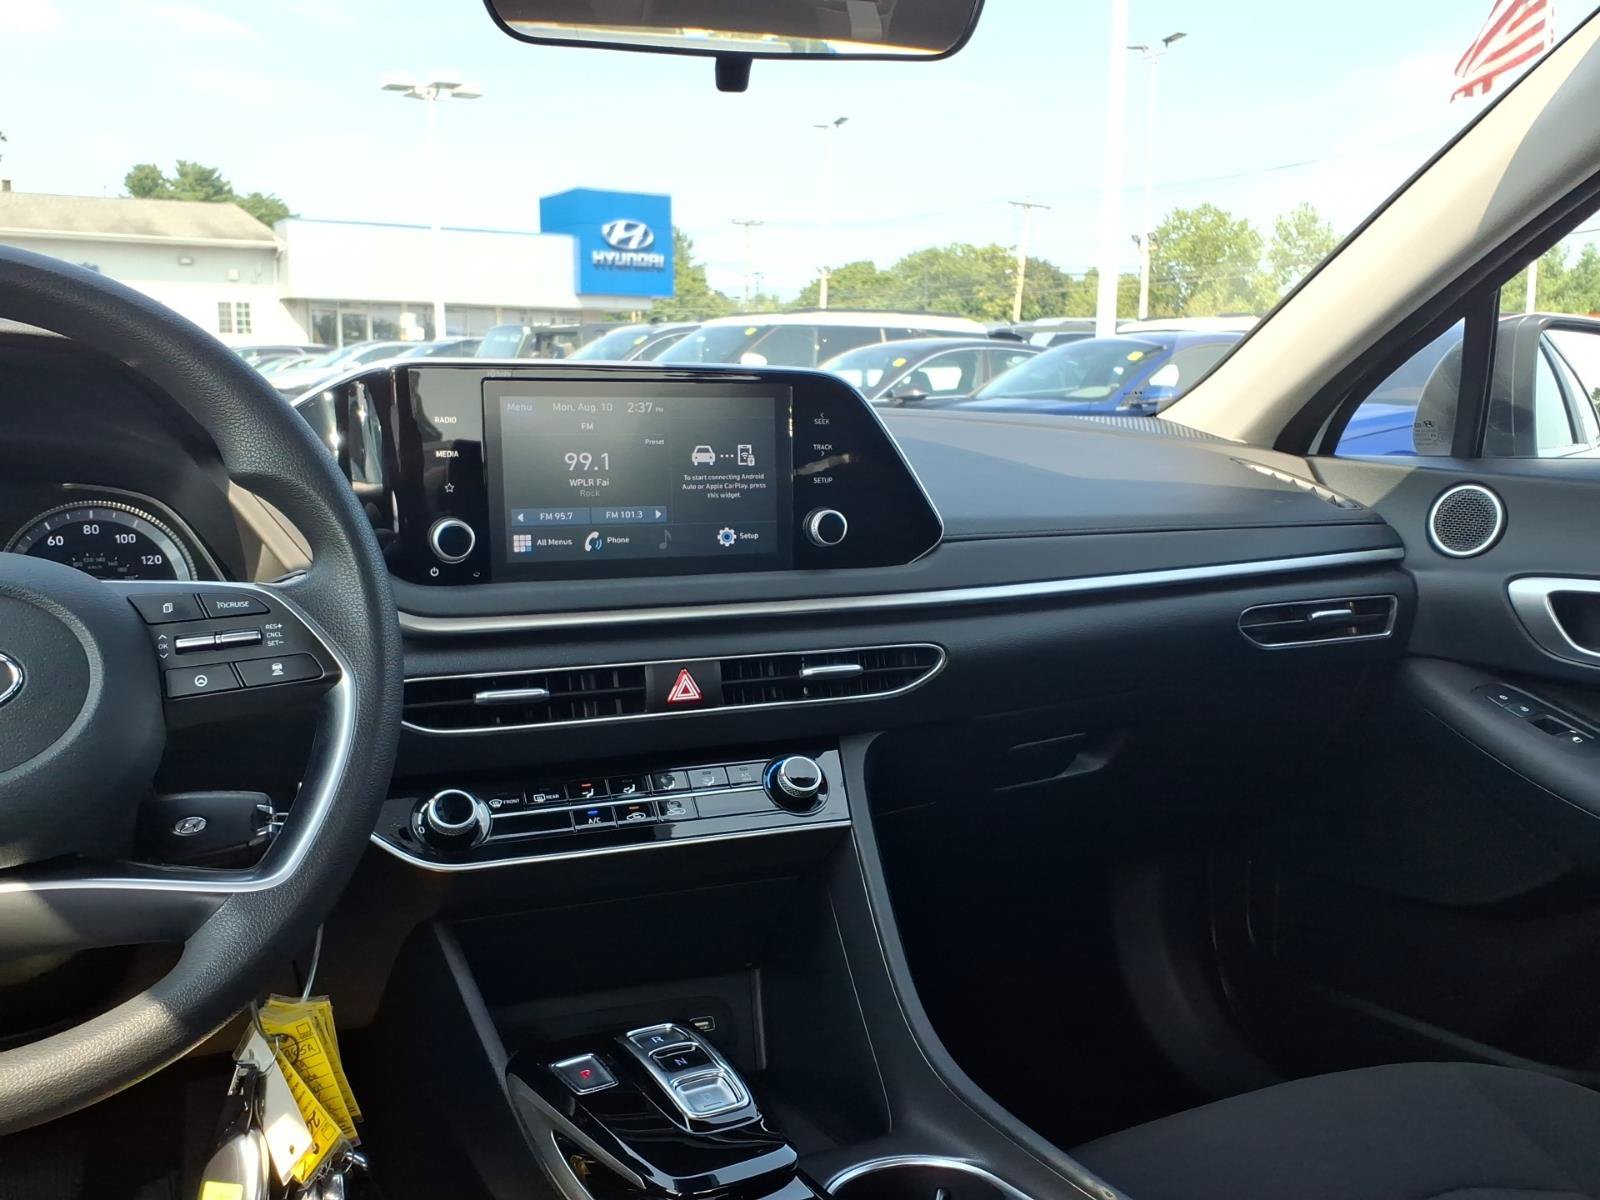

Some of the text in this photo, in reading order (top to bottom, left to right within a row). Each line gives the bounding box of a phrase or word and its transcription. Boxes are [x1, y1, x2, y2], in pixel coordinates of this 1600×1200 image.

[592, 250, 664, 268] HYUNDAI
[506, 402, 533, 412] Menu
[577, 402, 599, 413] Aug.
[601, 402, 613, 412] 10
[627, 402, 653, 413] 2:37
[434, 416, 457, 424] RADIO
[581, 422, 594, 430] FM
[435, 450, 459, 458] MEDIA
[564, 452, 609, 471] 99.1
[708, 473, 740, 481] connecting
[741, 472, 765, 480] Android
[569, 478, 610, 487] WPLR Fai
[705, 482, 723, 491] Apple
[749, 482, 767, 490] press
[579, 489, 600, 497] Rock
[720, 491, 742, 499] widget.
[540, 512, 573, 521] FM 95.7
[606, 510, 643, 519] FM 101.3
[82, 524, 100, 535] 80
[47, 535, 64, 546] 60
[115, 533, 137, 544] 100
[607, 536, 630, 544] Phone
[739, 532, 759, 540] Setup
[536, 538, 573, 546] All Menus
[141, 554, 162, 565] 120
[225, 600, 249, 608] CRUISE
[158, 642, 168, 650] OK
[588, 817, 602, 825] A/C
[651, 1035, 664, 1044] R
[674, 1056, 688, 1066] N
[579, 1068, 592, 1079] P
